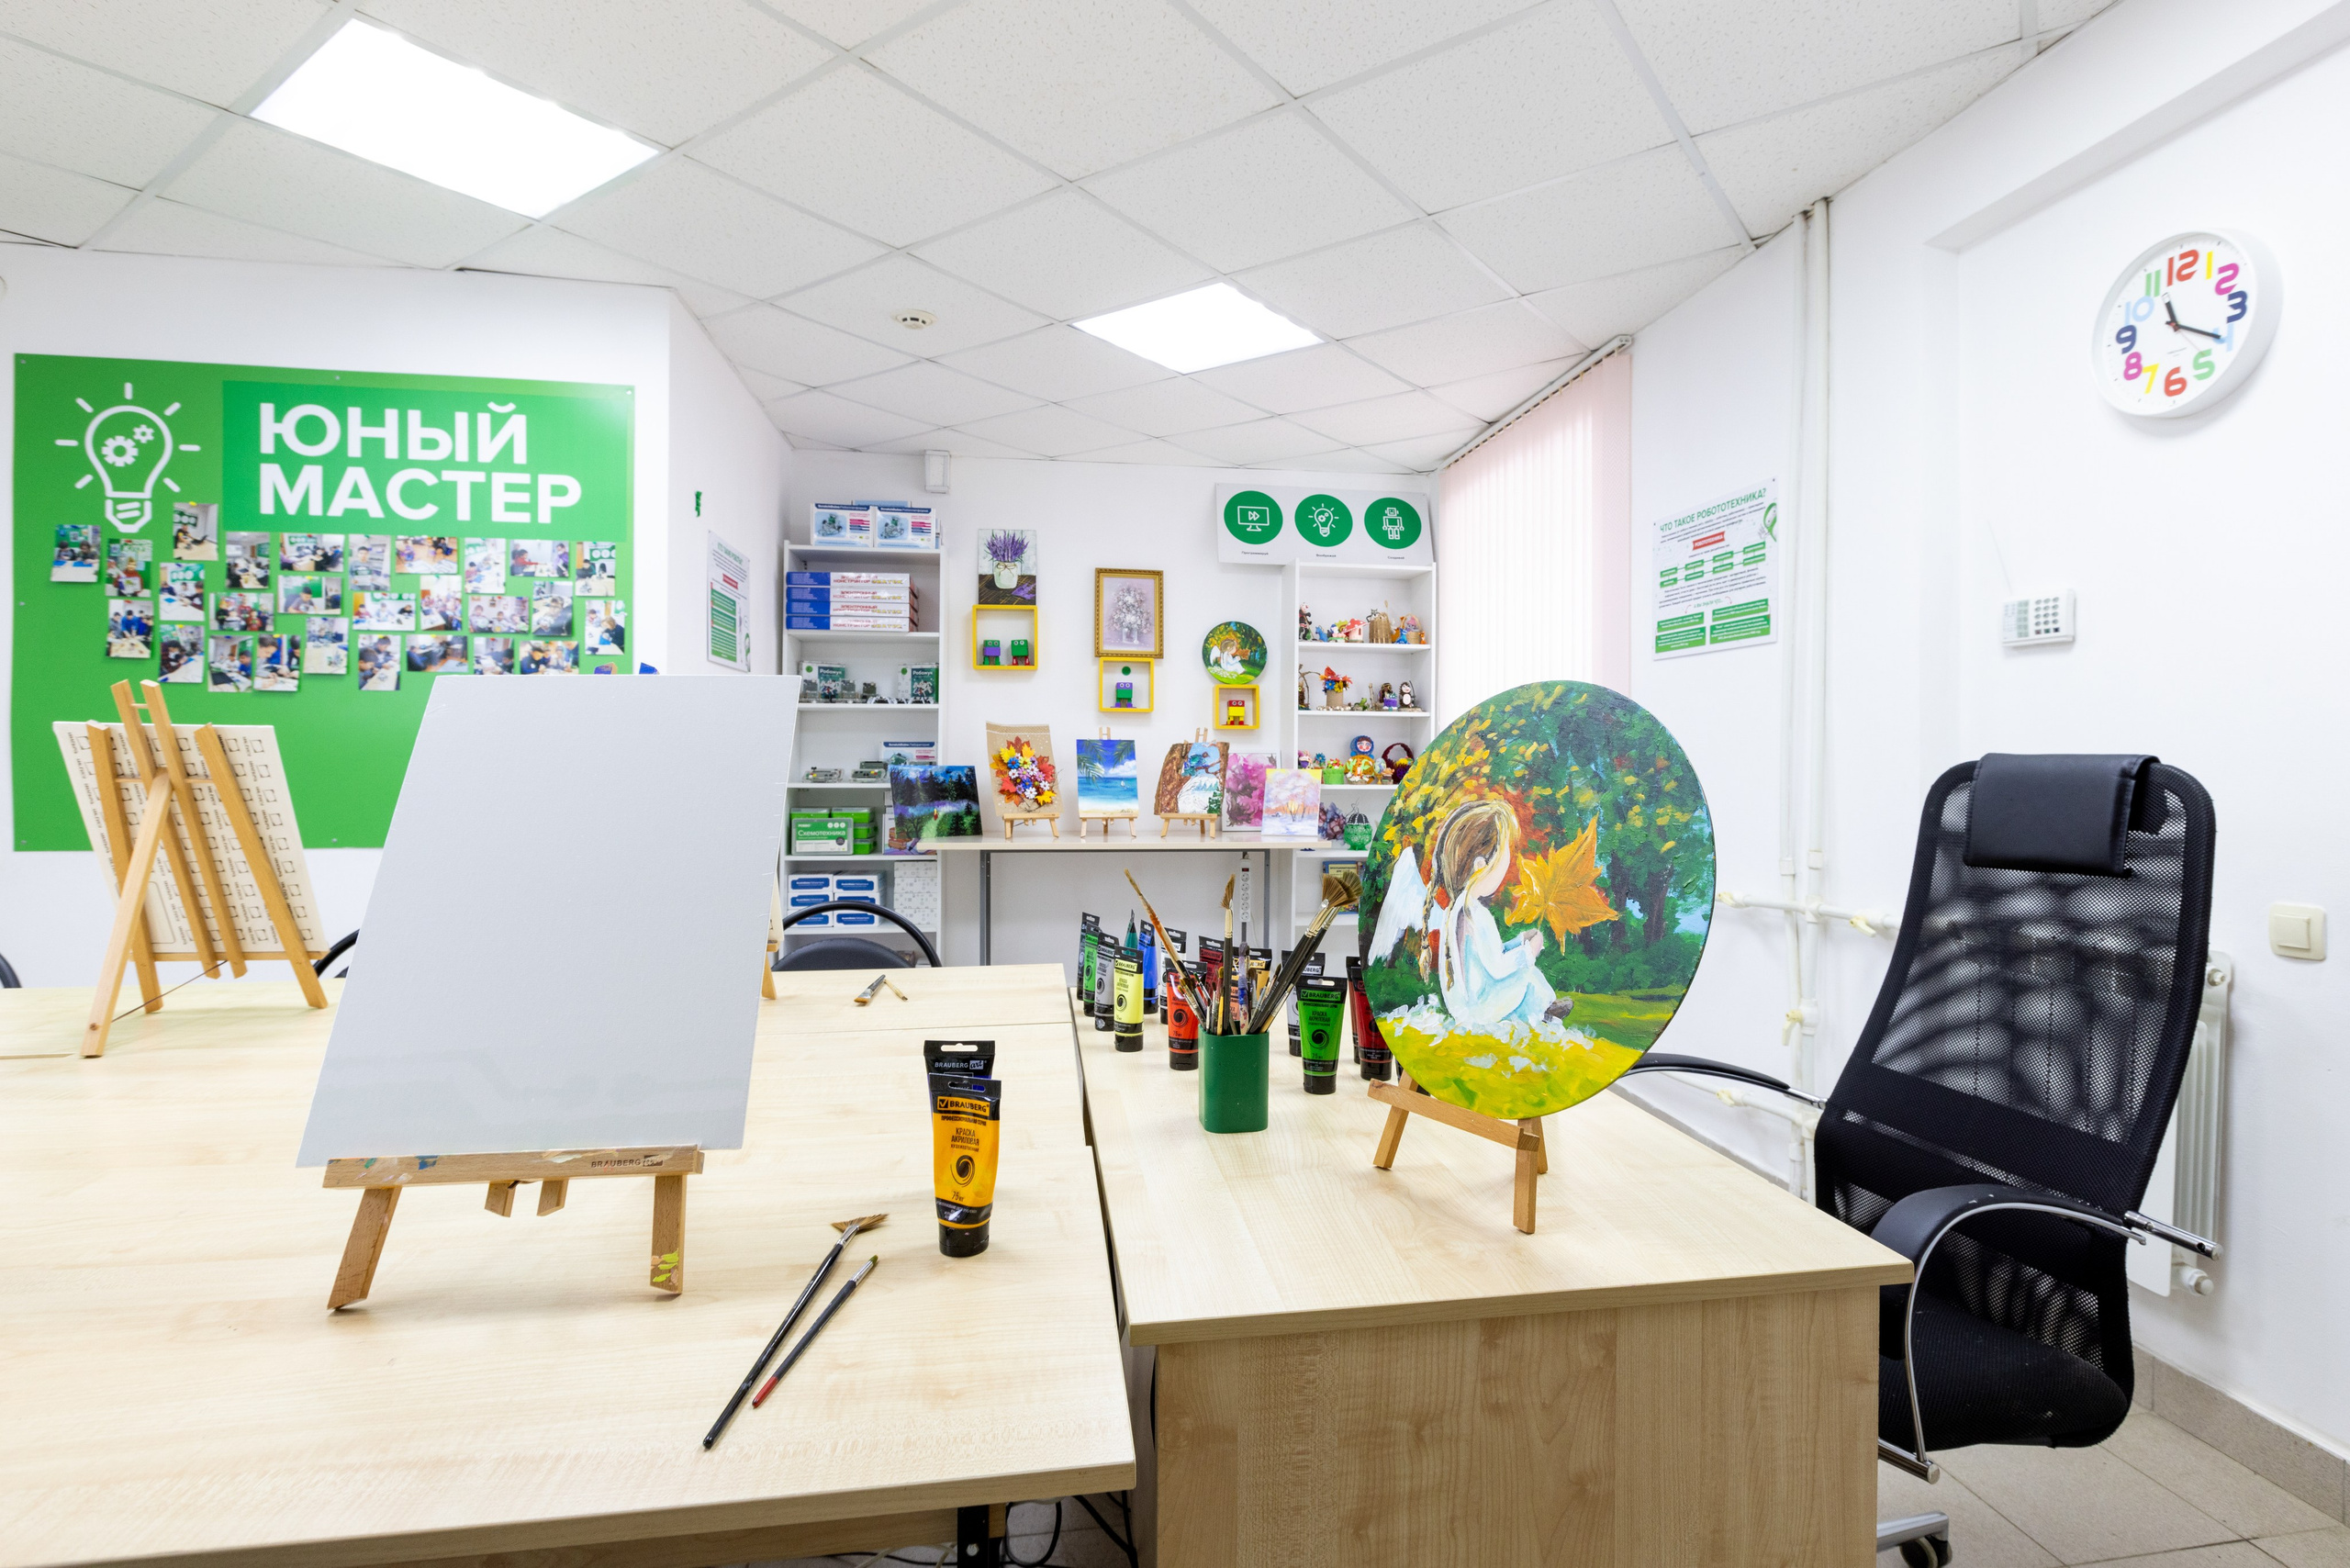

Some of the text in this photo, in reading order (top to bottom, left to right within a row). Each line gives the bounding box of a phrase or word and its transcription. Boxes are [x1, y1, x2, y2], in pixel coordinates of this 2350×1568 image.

[2166, 249, 2199, 287] 12
[2205, 251, 2213, 280] 1
[2214, 263, 2240, 297] 2
[2144, 269, 2161, 297] 11
[2124, 295, 2155, 326] 10
[2226, 290, 2248, 323] 3
[2115, 324, 2137, 355] 9
[2212, 322, 2234, 353] 4
[2123, 351, 2143, 382] 8
[2142, 363, 2160, 395] 7
[2192, 348, 2216, 382] 5
[2164, 366, 2188, 398] 6
[259, 401, 528, 465] ЮНЫЙ
[259, 463, 583, 525] МАСТЕР
[1660, 521, 1673, 532] ЧТО
[1673, 513, 1695, 529] ТАКОЕ
[1696, 487, 1767, 521] РОБОТОТЕХНИКА?
[970, 1061, 983, 1070] art
[949, 1100, 987, 1113] BRAUBERG
[951, 1136, 979, 1147] АКРИЛОВАЯ
[956, 1127, 976, 1137] КРАСКА
[590, 1159, 641, 1168] BRAUBERG
